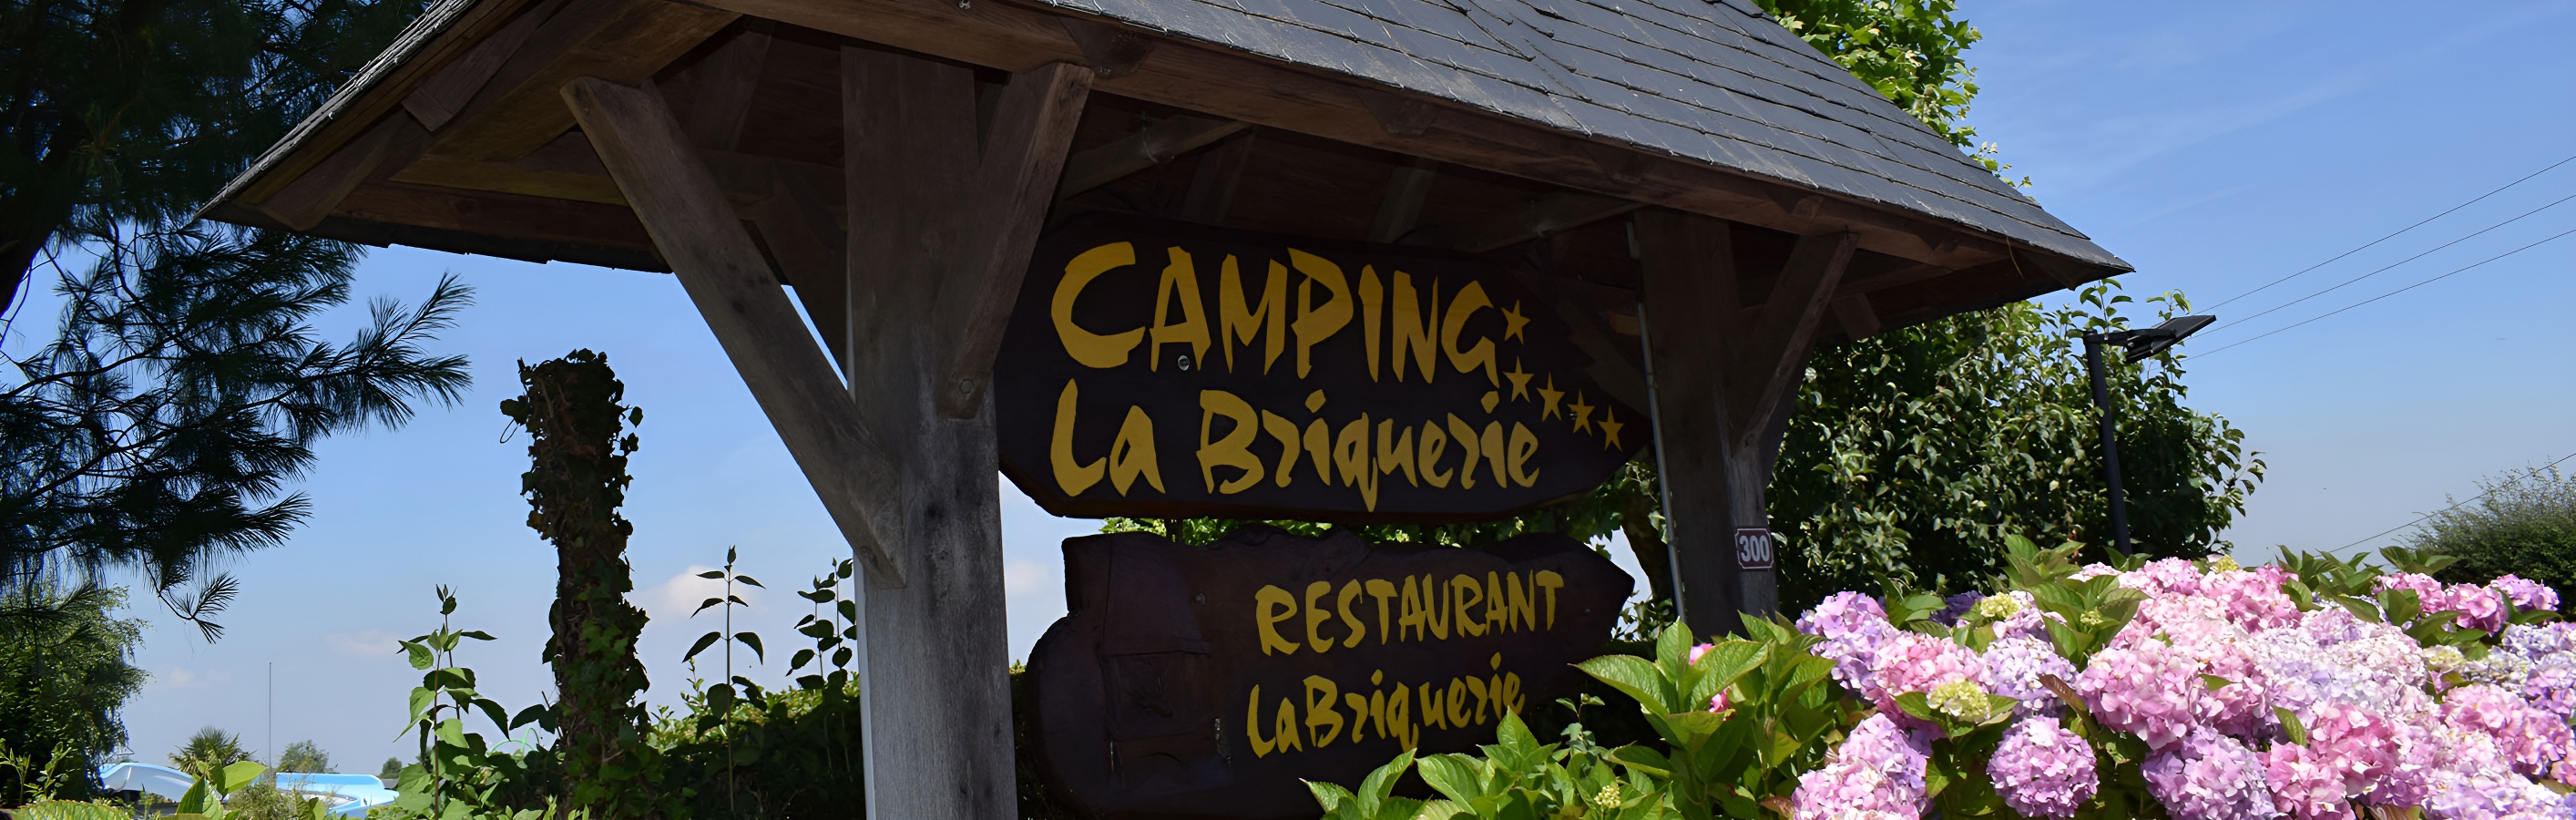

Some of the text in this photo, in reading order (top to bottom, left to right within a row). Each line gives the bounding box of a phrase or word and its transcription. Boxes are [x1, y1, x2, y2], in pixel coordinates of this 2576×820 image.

[1050, 241, 1499, 389] CAMPING
[1050, 378, 1540, 512] La Briquerie
[1739, 535, 1770, 562] 300
[1254, 569, 1564, 657] RESTAURANT
